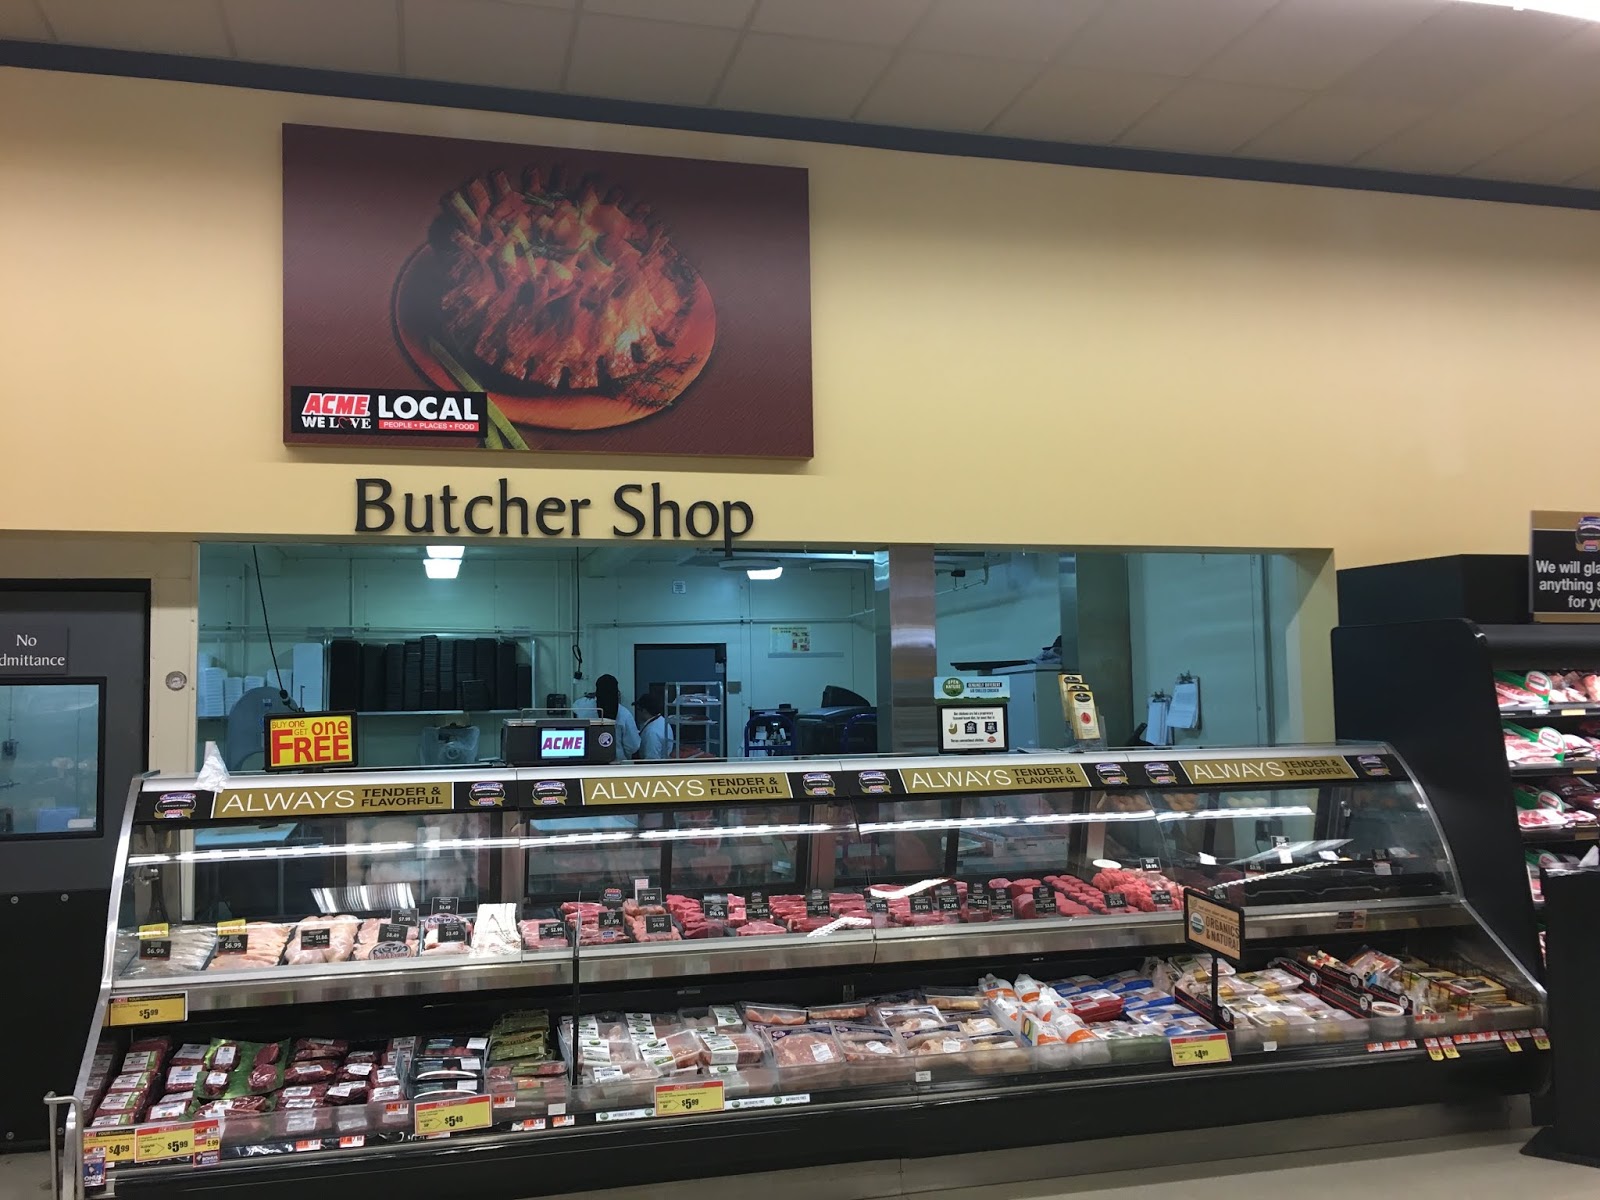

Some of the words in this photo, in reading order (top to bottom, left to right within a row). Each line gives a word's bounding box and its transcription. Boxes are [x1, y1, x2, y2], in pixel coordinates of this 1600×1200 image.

[302, 393, 370, 416] ACME
[378, 395, 479, 421] LOCAL
[302, 416, 326, 428] WE
[355, 477, 591, 538] Butcher
[613, 482, 755, 557] Shop
[1536, 560, 1556, 573] We
[1559, 561, 1580, 574] will
[1539, 578, 1593, 594] anything
[1568, 596, 1587, 608] for
[16, 634, 37, 647] No
[0, 654, 65, 667] dmittance
[272, 721, 287, 729] BUY
[288, 720, 305, 728] one
[311, 720, 348, 735] one
[294, 728, 308, 736] GET
[272, 729, 349, 764] FREE
[542, 737, 583, 750] ACME
[1282, 759, 1329, 768] TENDER
[1331, 758, 1340, 767] &
[1012, 767, 1064, 777] TENDER
[1066, 767, 1075, 775] &
[1194, 761, 1284, 780] ALWAYS
[1288, 766, 1348, 777] FLAVORFUL
[709, 777, 767, 787] TENDER
[769, 776, 778, 785] &
[912, 769, 1012, 789] ALWAYS
[1016, 774, 1081, 785] FLAVORFUL
[361, 787, 428, 798] TENDER
[431, 786, 441, 796] &
[591, 779, 705, 800] ALWAYS
[710, 784, 782, 796] FLAVORFUL
[222, 790, 354, 813] ALWAYS
[361, 794, 443, 807] FLAVORFUL
[1206, 915, 1240, 939] ORGANICS
